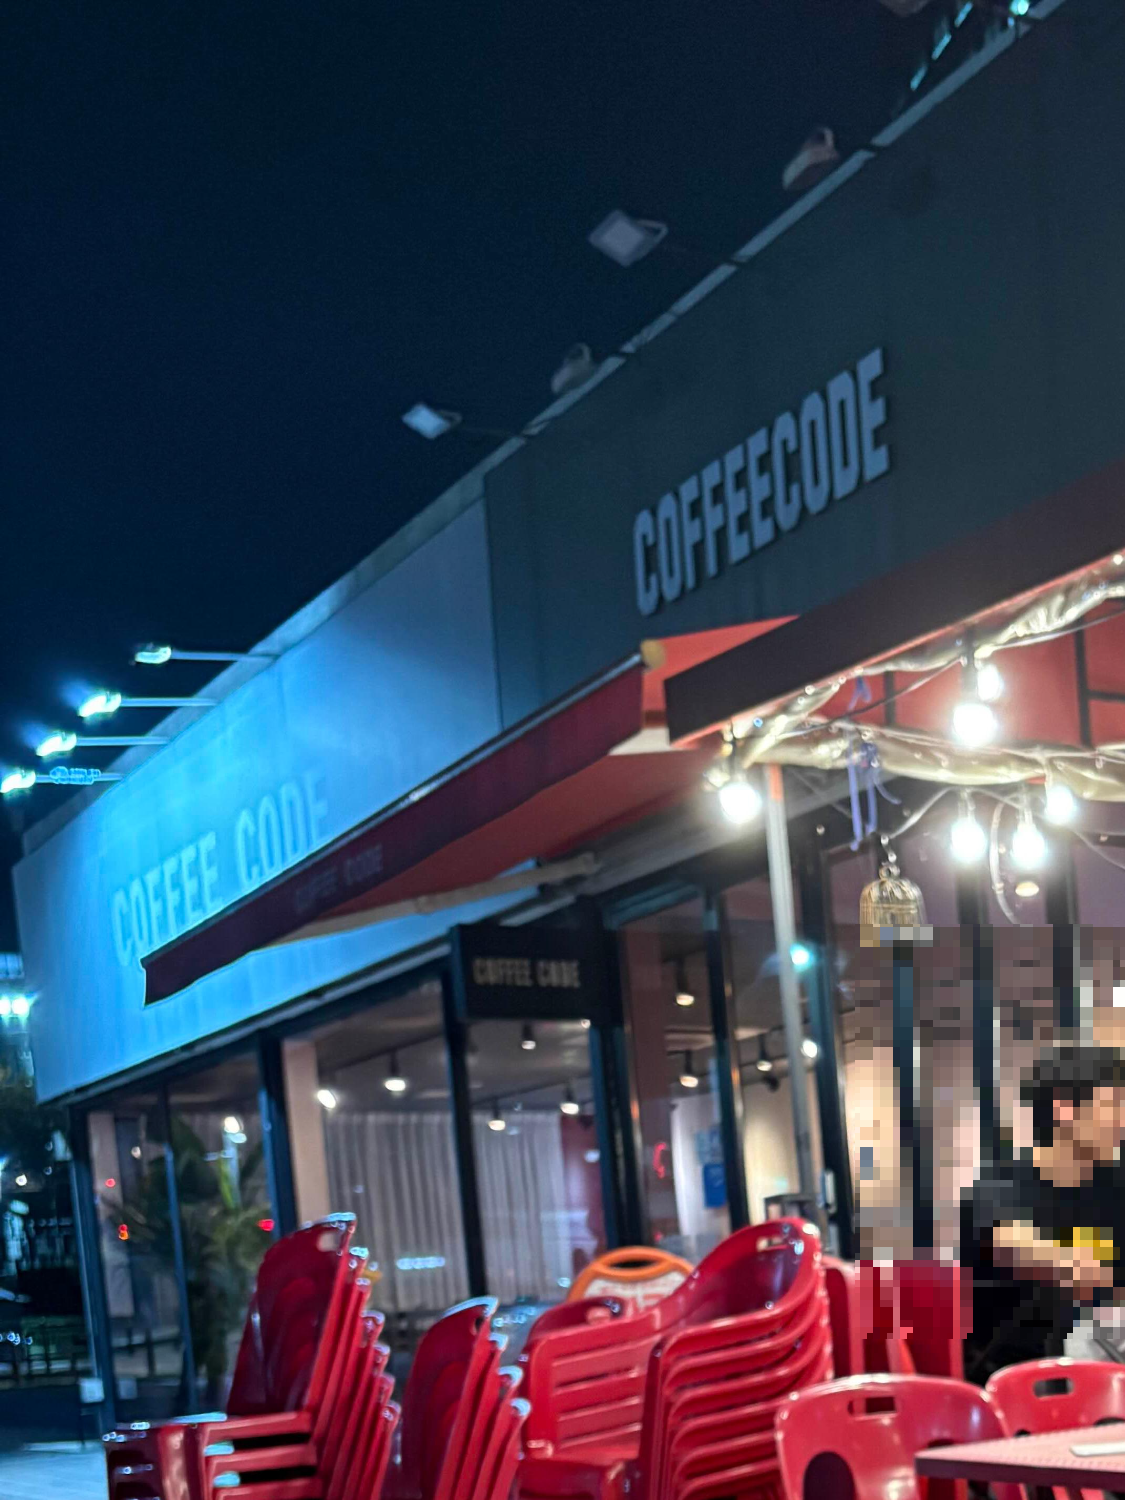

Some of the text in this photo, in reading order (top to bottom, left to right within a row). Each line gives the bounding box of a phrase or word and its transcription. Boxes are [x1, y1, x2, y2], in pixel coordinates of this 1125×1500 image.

[632, 346, 890, 616] COFFEECODE
[111, 771, 328, 966] COFFEE CODE
